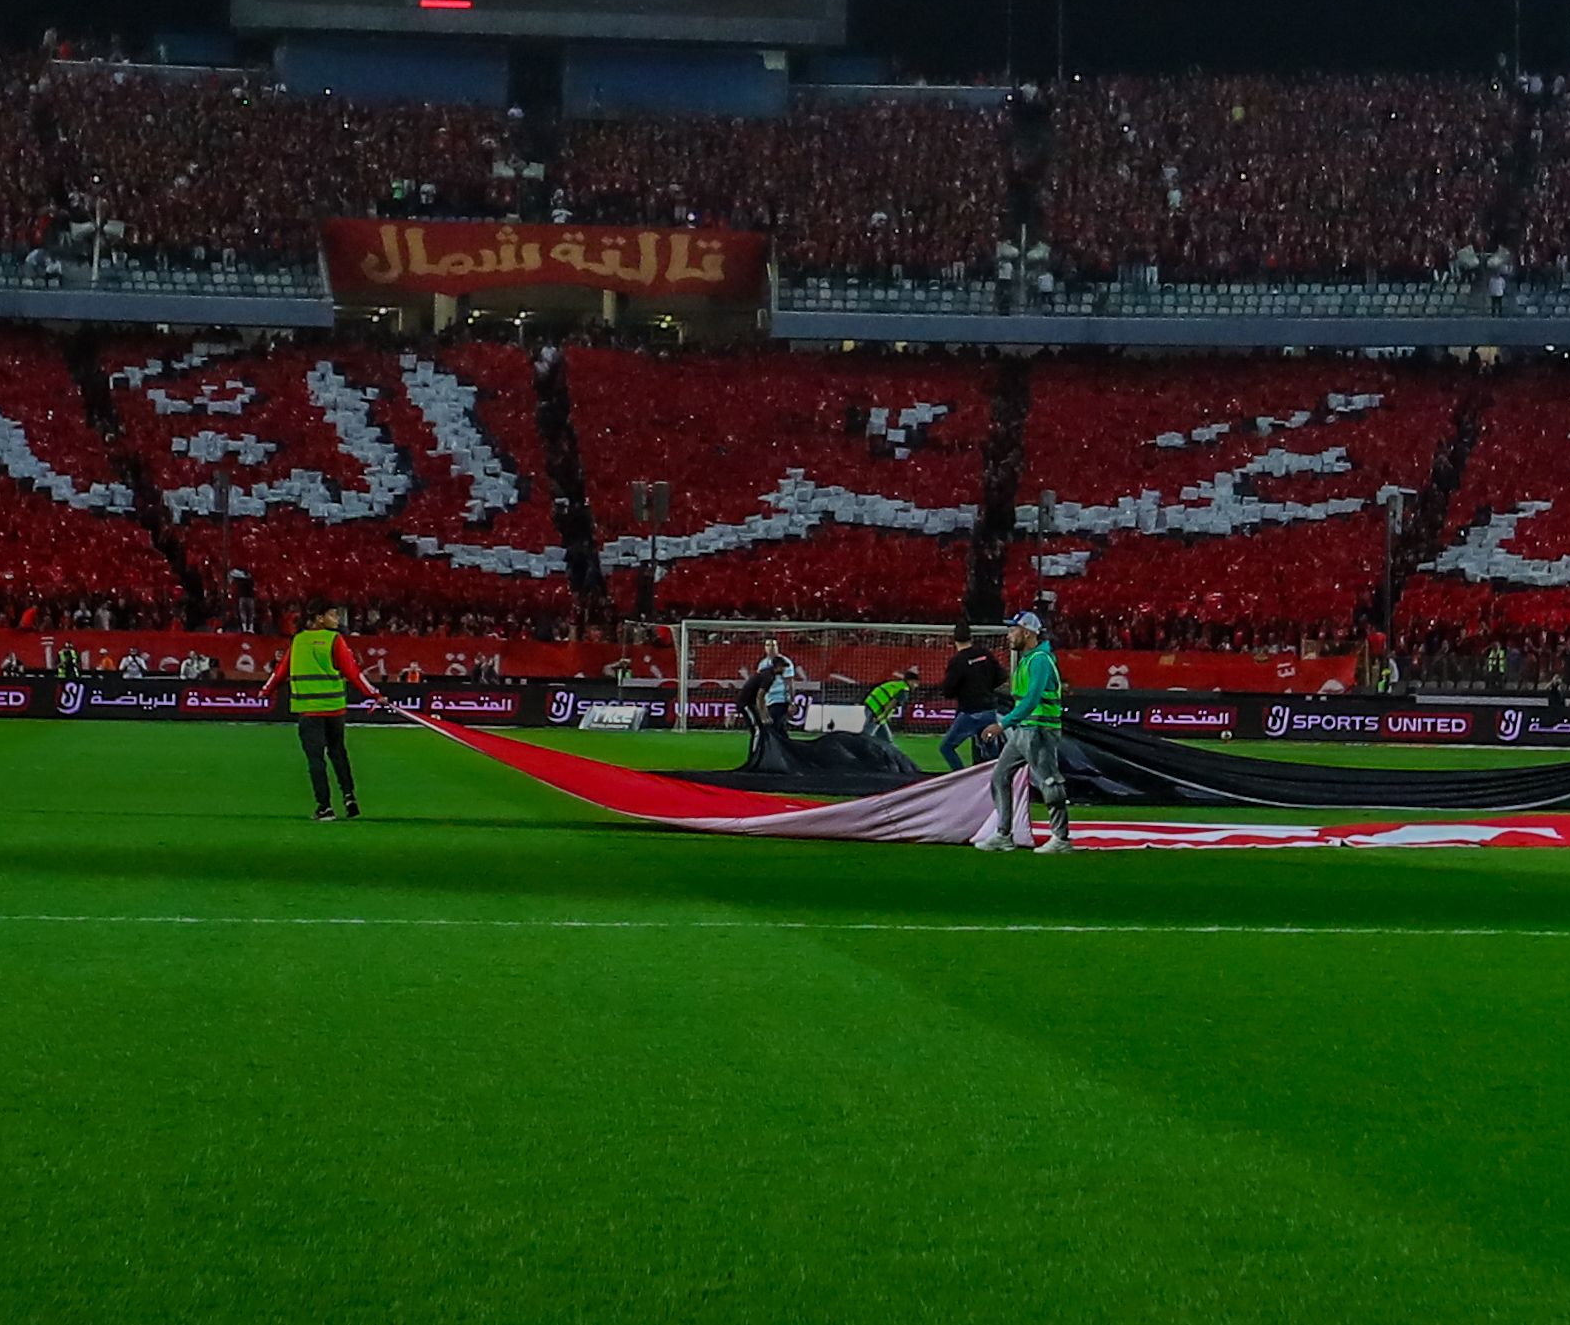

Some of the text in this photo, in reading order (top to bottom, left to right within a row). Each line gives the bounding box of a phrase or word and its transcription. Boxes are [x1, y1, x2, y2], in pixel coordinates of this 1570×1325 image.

[360, 224, 542, 284] شمال
[90, 689, 176, 711] للرياضة
[186, 691, 270, 708] المتحدة
[430, 695, 512, 711] المتحدة
[674, 702, 743, 717] UNITE
[1149, 708, 1230, 725] المتحدة
[1292, 714, 1379, 731] SPORTS
[1388, 716, 1467, 733] UNITED
